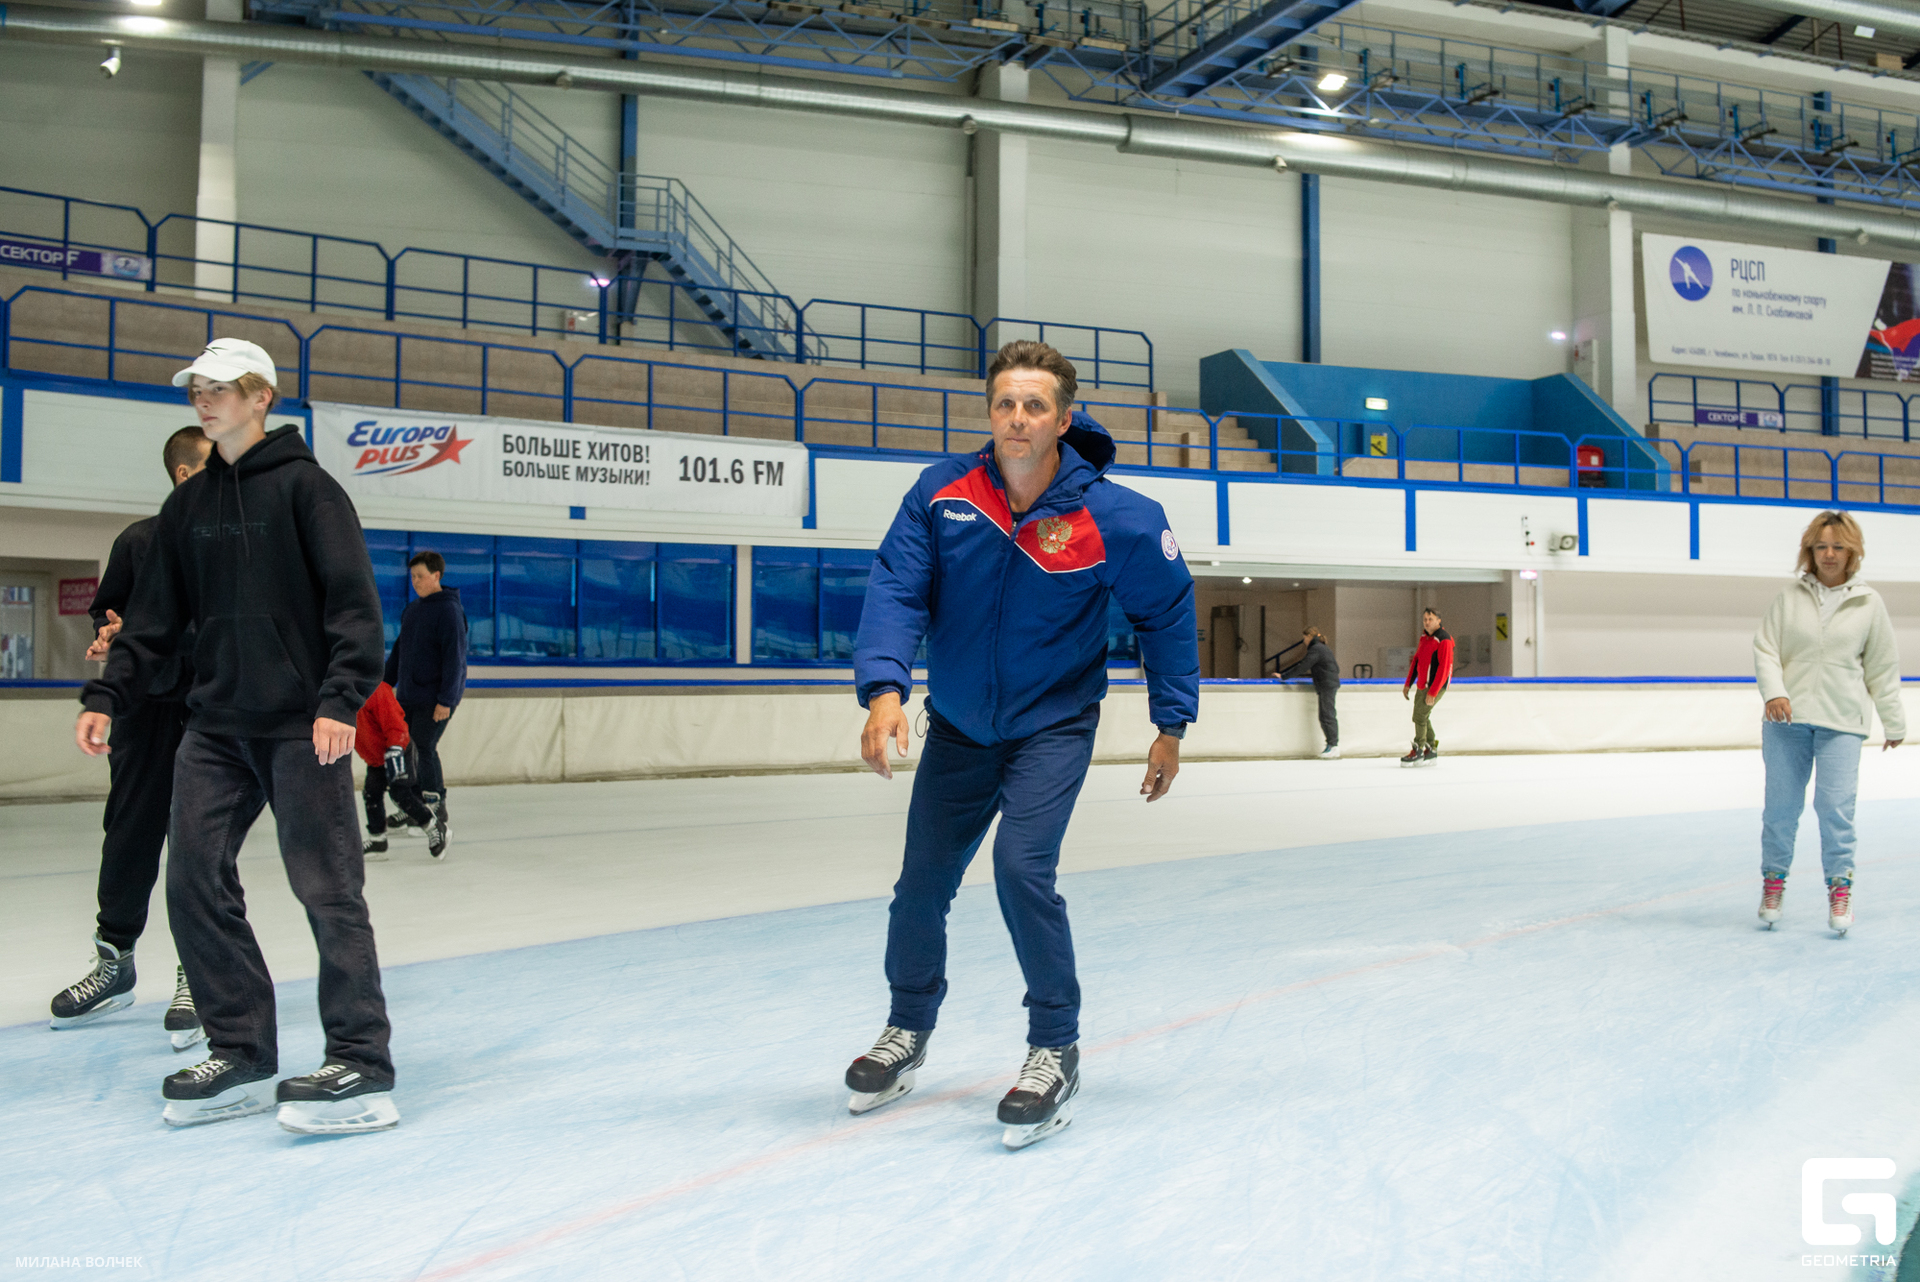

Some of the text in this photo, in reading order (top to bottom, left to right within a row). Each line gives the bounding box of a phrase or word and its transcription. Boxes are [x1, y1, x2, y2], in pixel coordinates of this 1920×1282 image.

[1, 245, 80, 266] СЕКТОР F
[1730, 258, 1766, 283] РЦСП
[1731, 288, 1741, 298] по
[1803, 295, 1827, 309] спорту
[346, 420, 451, 447] Europa
[502, 433, 651, 464] БОЛЬШЕ ХИТОВ!
[502, 460, 651, 486] БОЛЬШЕ МУЗЫКИ!
[678, 455, 785, 487] 101.6 FM
[943, 508, 977, 522] Reebok
